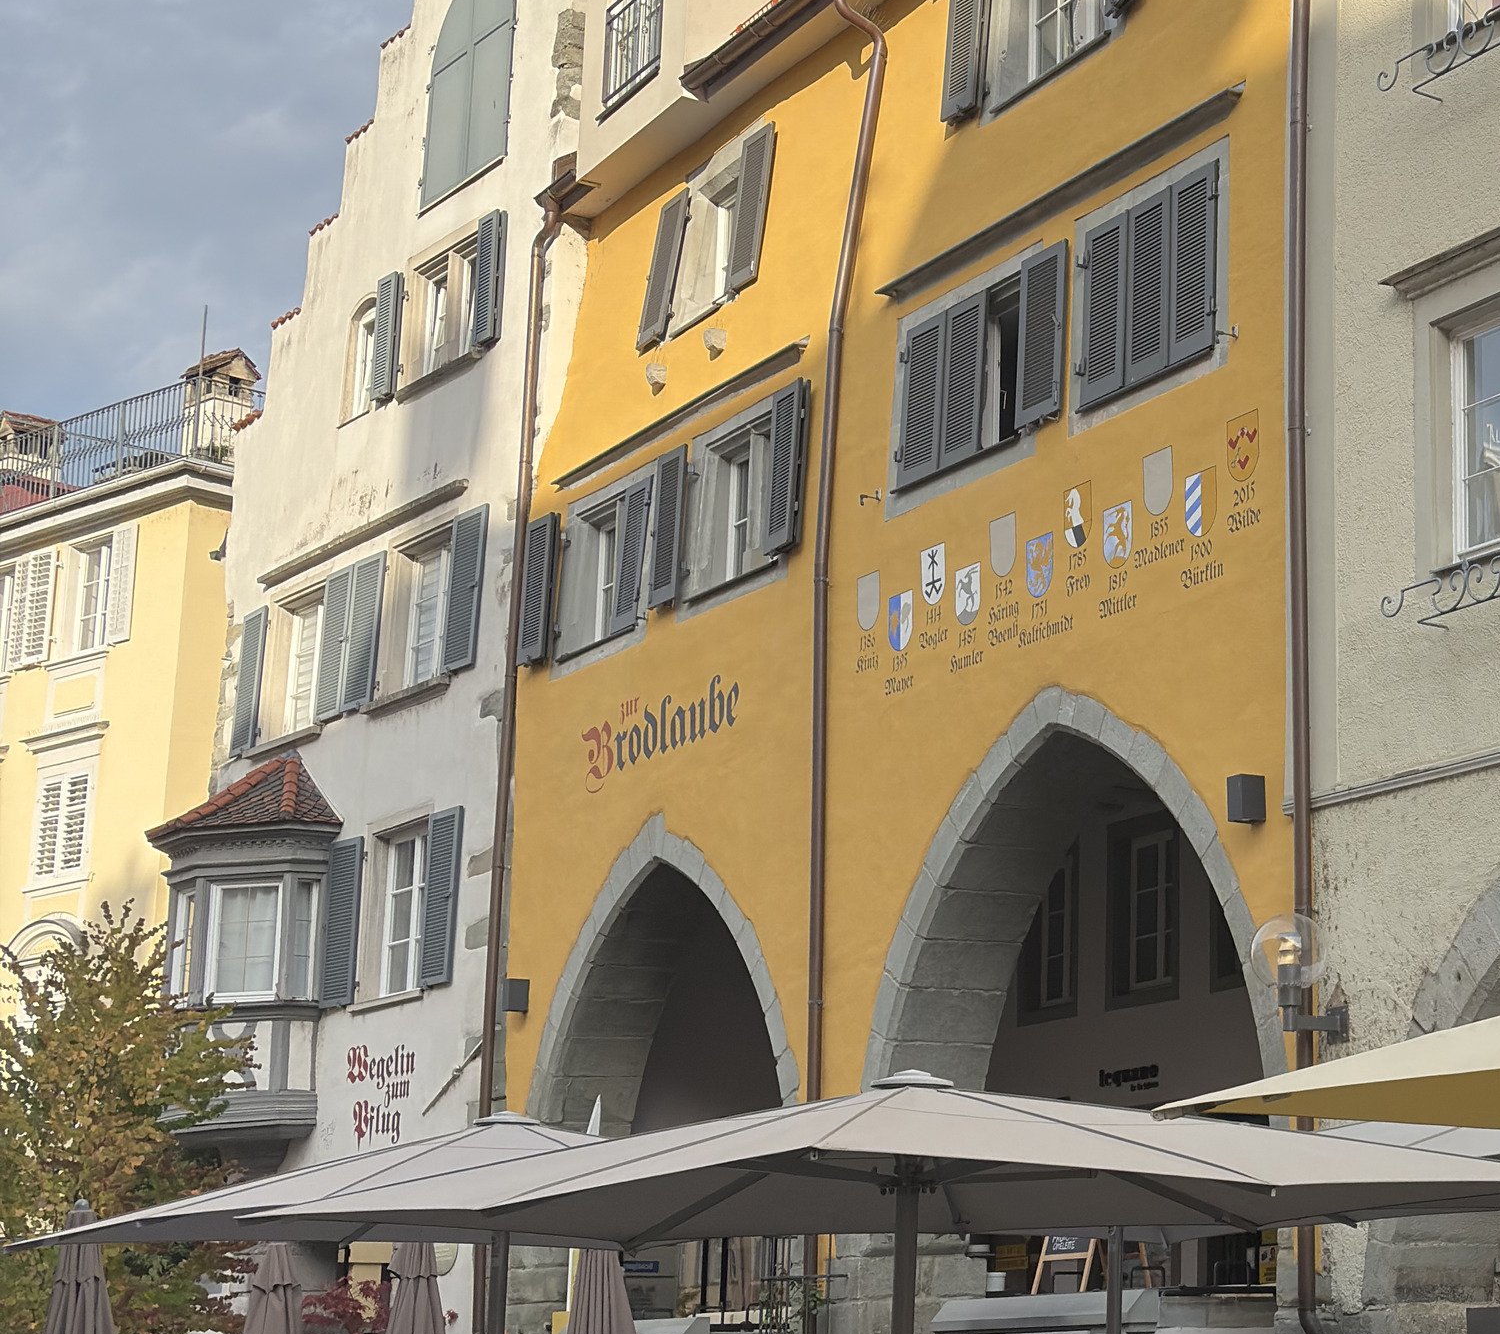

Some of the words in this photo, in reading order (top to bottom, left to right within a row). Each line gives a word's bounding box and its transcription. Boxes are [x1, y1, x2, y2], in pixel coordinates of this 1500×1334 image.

[1233, 481, 1255, 508] 2015
[1150, 516, 1169, 540] 1855
[1227, 507, 1261, 533] Wilde
[1069, 548, 1086, 572] 1785
[1134, 538, 1185, 569] Madlener
[1190, 539, 1213, 563] 1900
[1066, 573, 1090, 597] Frey
[1108, 570, 1128, 594] 1819
[1181, 560, 1224, 589] Bürklin
[995, 579, 1013, 600] 1542
[926, 605, 942, 625] 1414
[988, 601, 1019, 626] Häring
[1031, 599, 1048, 621] 1751
[1099, 592, 1137, 619] Mittler
[919, 627, 948, 650] Vogler
[958, 627, 977, 649] 1487
[892, 652, 908, 672] 1395
[950, 649, 983, 675] Humler
[620, 696, 640, 725] zur
[581, 674, 740, 794] Brodlaube
[346, 1044, 416, 1090] Wegelin
[384, 1079, 411, 1108] zum
[353, 1099, 401, 1152] Pflug
